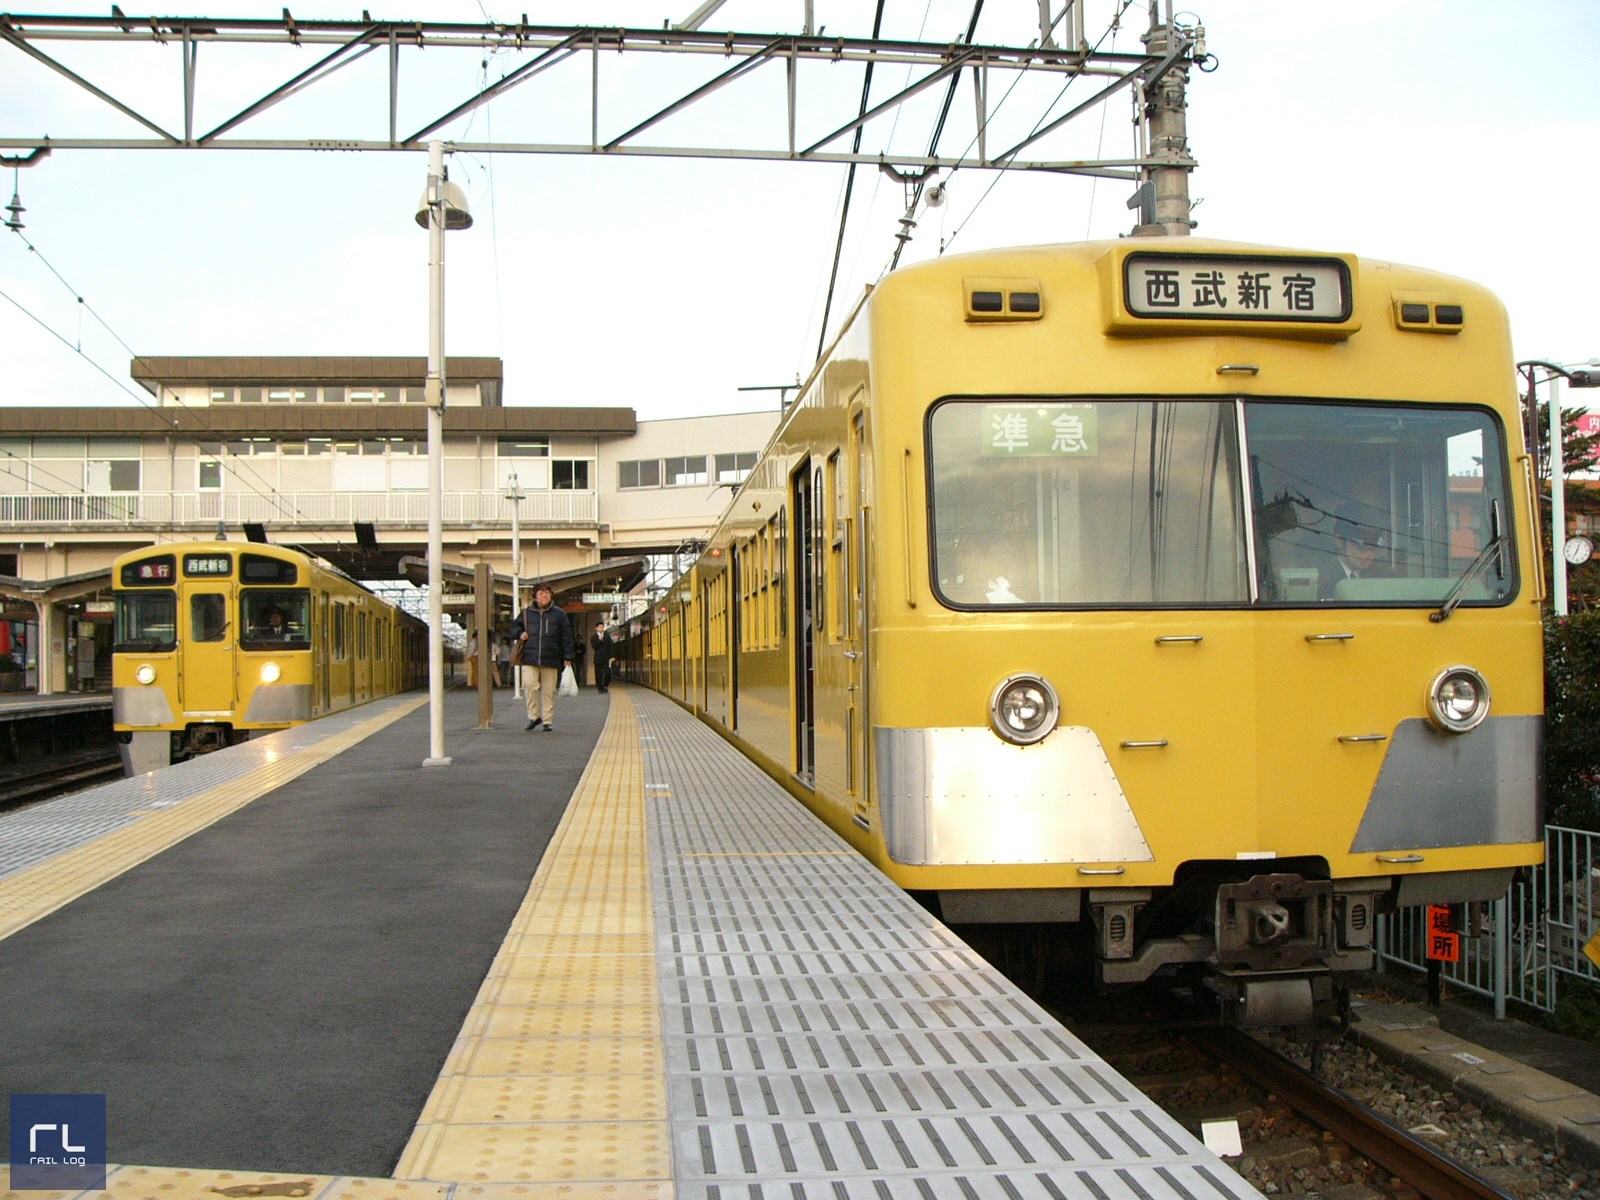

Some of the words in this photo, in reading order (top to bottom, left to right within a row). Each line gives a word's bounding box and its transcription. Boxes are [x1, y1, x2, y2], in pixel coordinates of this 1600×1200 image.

[1144, 269, 1316, 311] 西武新宿
[992, 413, 1088, 453] 準急
[141, 564, 170, 578] 急行
[188, 559, 228, 573] 西武新宿
[1432, 904, 1453, 958] 場所
